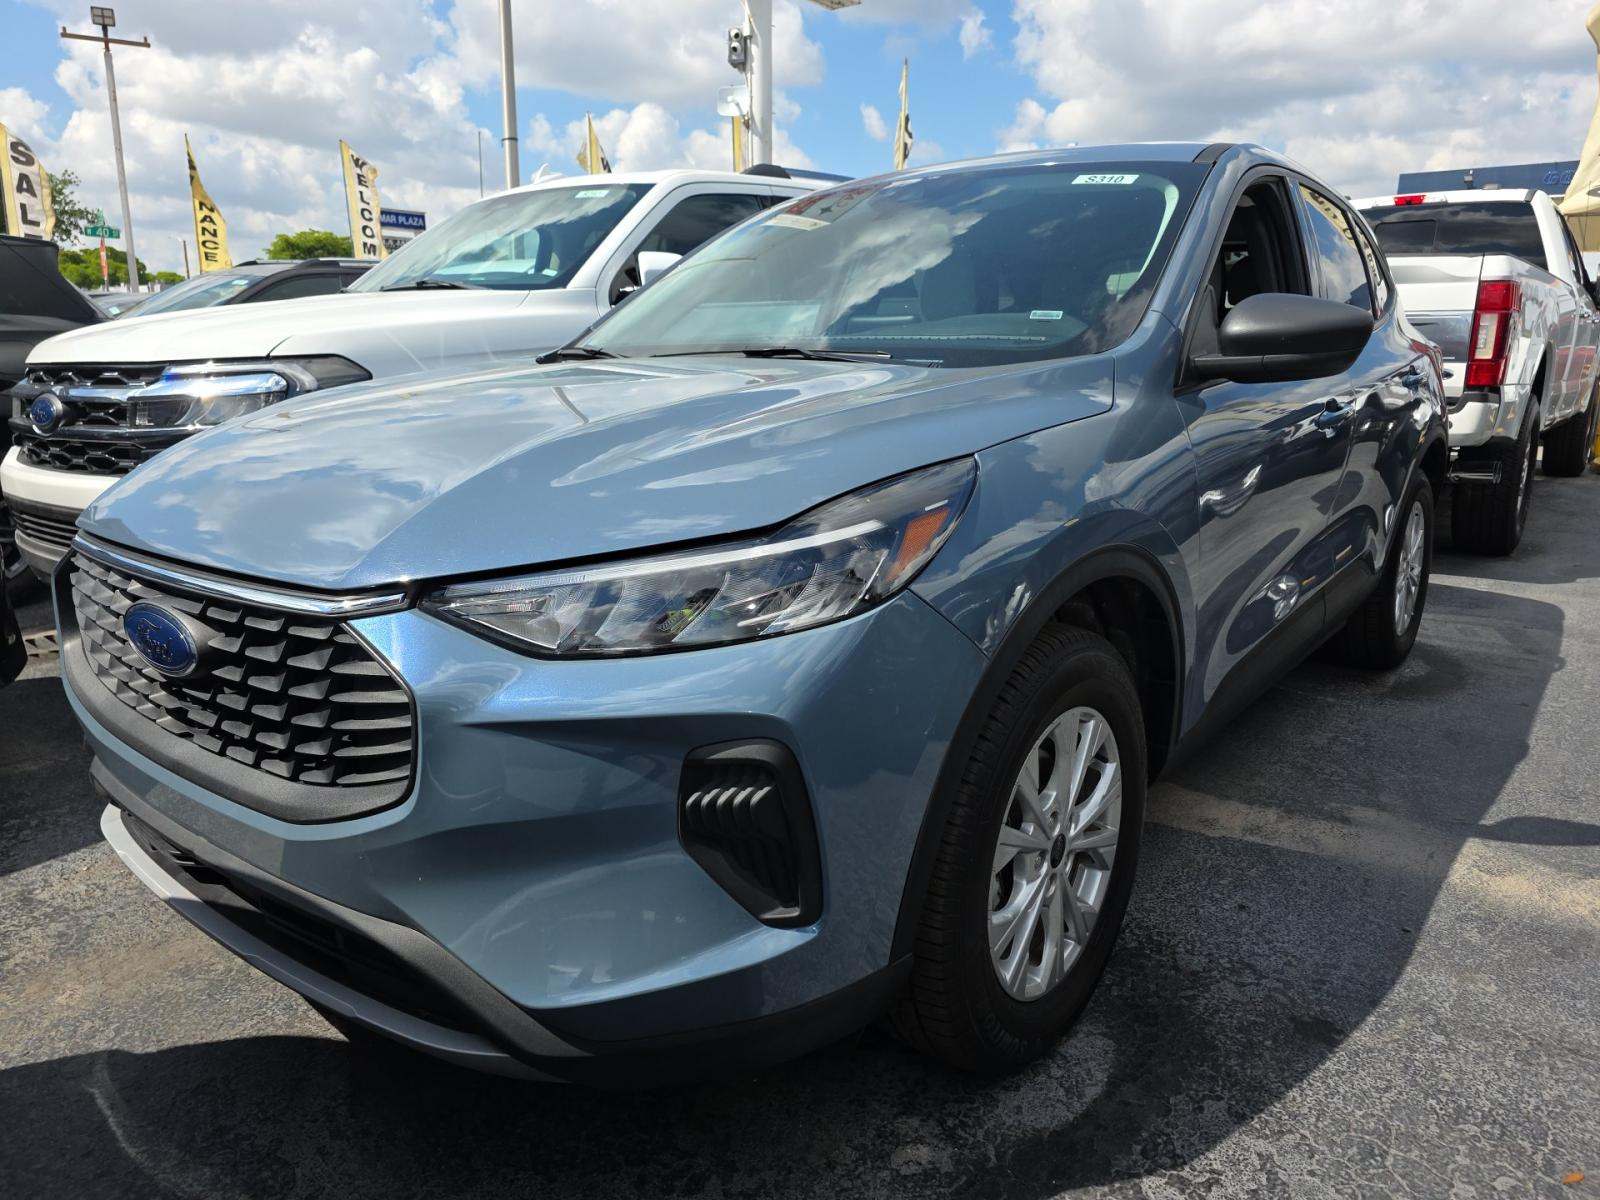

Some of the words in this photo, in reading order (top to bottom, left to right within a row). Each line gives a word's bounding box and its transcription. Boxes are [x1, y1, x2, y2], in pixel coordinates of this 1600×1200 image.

[10, 141, 42, 240] SAL
[351, 154, 377, 256] WELCOM
[96, 227, 109, 237] 40
[398, 215, 424, 227] PLAZA
